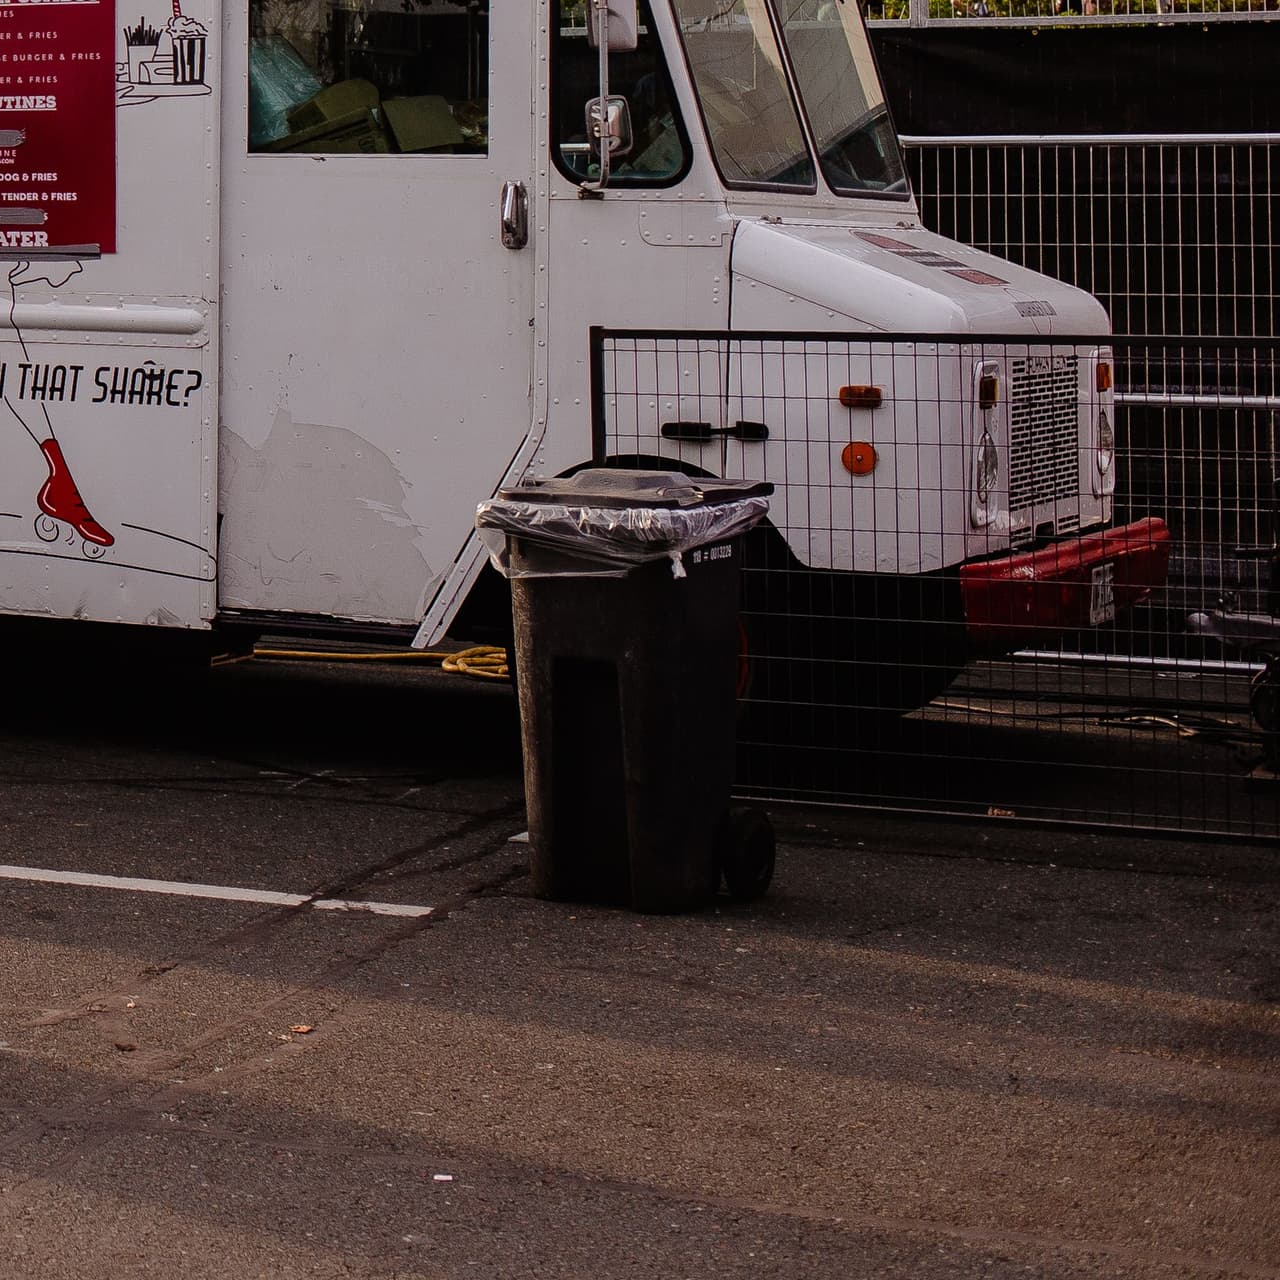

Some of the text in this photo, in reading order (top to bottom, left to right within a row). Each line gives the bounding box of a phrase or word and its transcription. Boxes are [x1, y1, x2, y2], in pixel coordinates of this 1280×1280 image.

[17, 32, 23, 40] &
[29, 31, 58, 40] FRIES
[13, 53, 53, 61] BURGER
[71, 52, 101, 60] FRIES
[17, 76, 23, 84] &
[29, 75, 58, 84] FRIES
[22, 173, 29, 181] &
[31, 172, 58, 181] FRIES
[1, 193, 38, 201] TENDER
[41, 193, 48, 201] &
[51, 192, 78, 201] FRIES
[18, 363, 85, 402] THAT
[92, 365, 203, 407] SHAKE?
